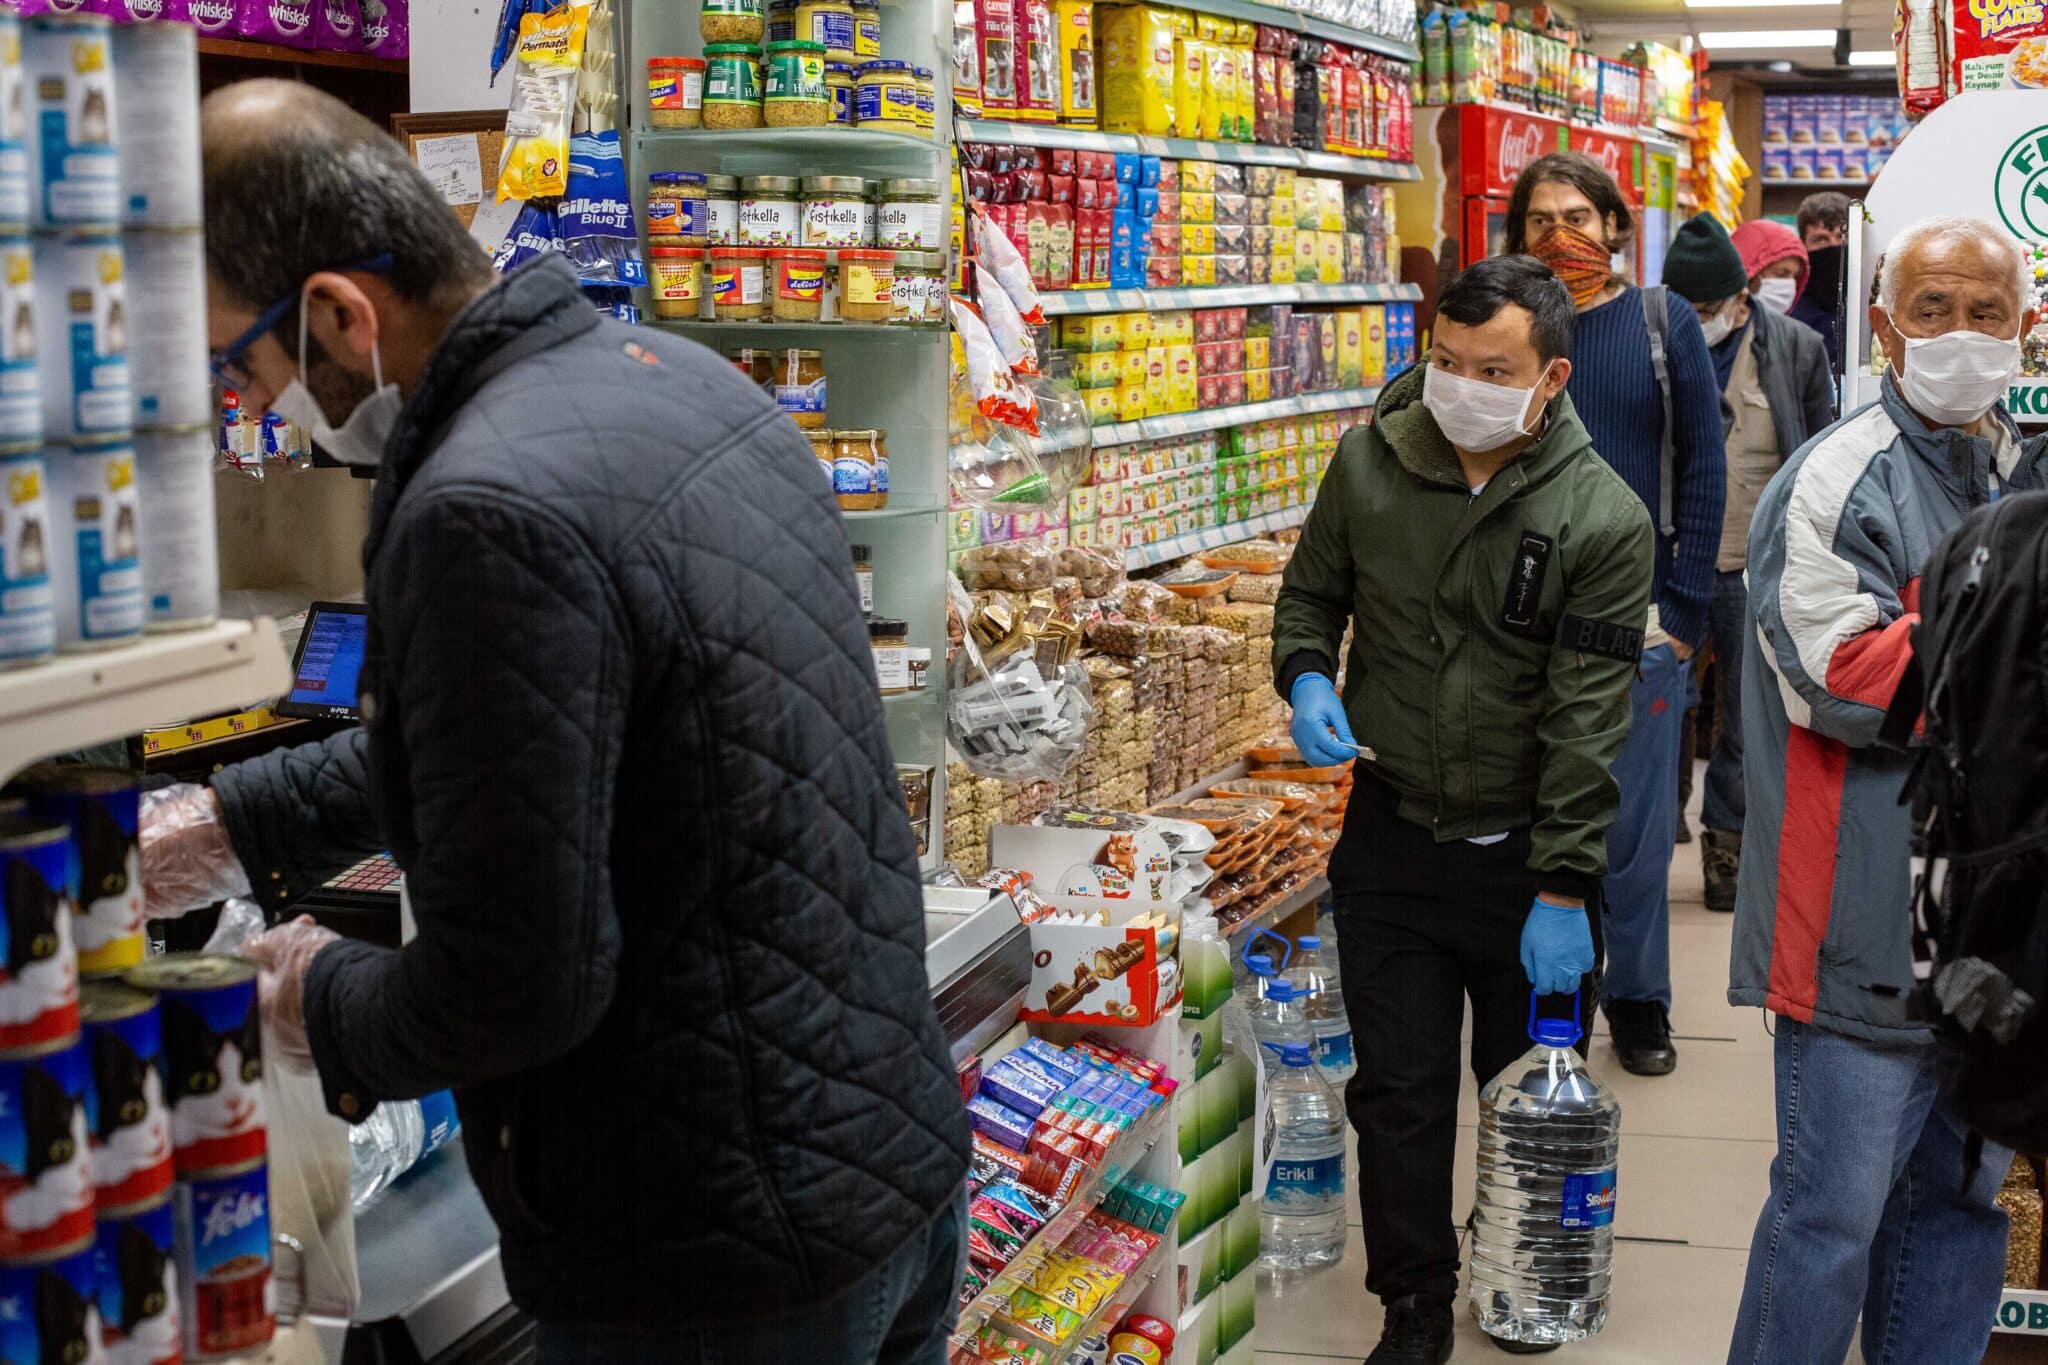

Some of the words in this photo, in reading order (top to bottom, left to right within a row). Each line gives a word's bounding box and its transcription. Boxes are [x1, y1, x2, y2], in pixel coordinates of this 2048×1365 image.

[188, 2, 233, 21] whiskas
[268, 5, 310, 27] whiskas
[1980, 5, 2044, 38] FLAKES
[361, 23, 390, 39] skas
[520, 36, 569, 52] Permatik
[554, 47, 568, 55] 10
[557, 198, 629, 218] Gillette
[581, 213, 614, 225] Blue
[625, 261, 645, 279] 5T
[619, 307, 637, 325] 5T
[1276, 1166, 1314, 1182] Erikli
[1033, 1312, 1054, 1333] First
[1994, 1300, 2048, 1330] OB
